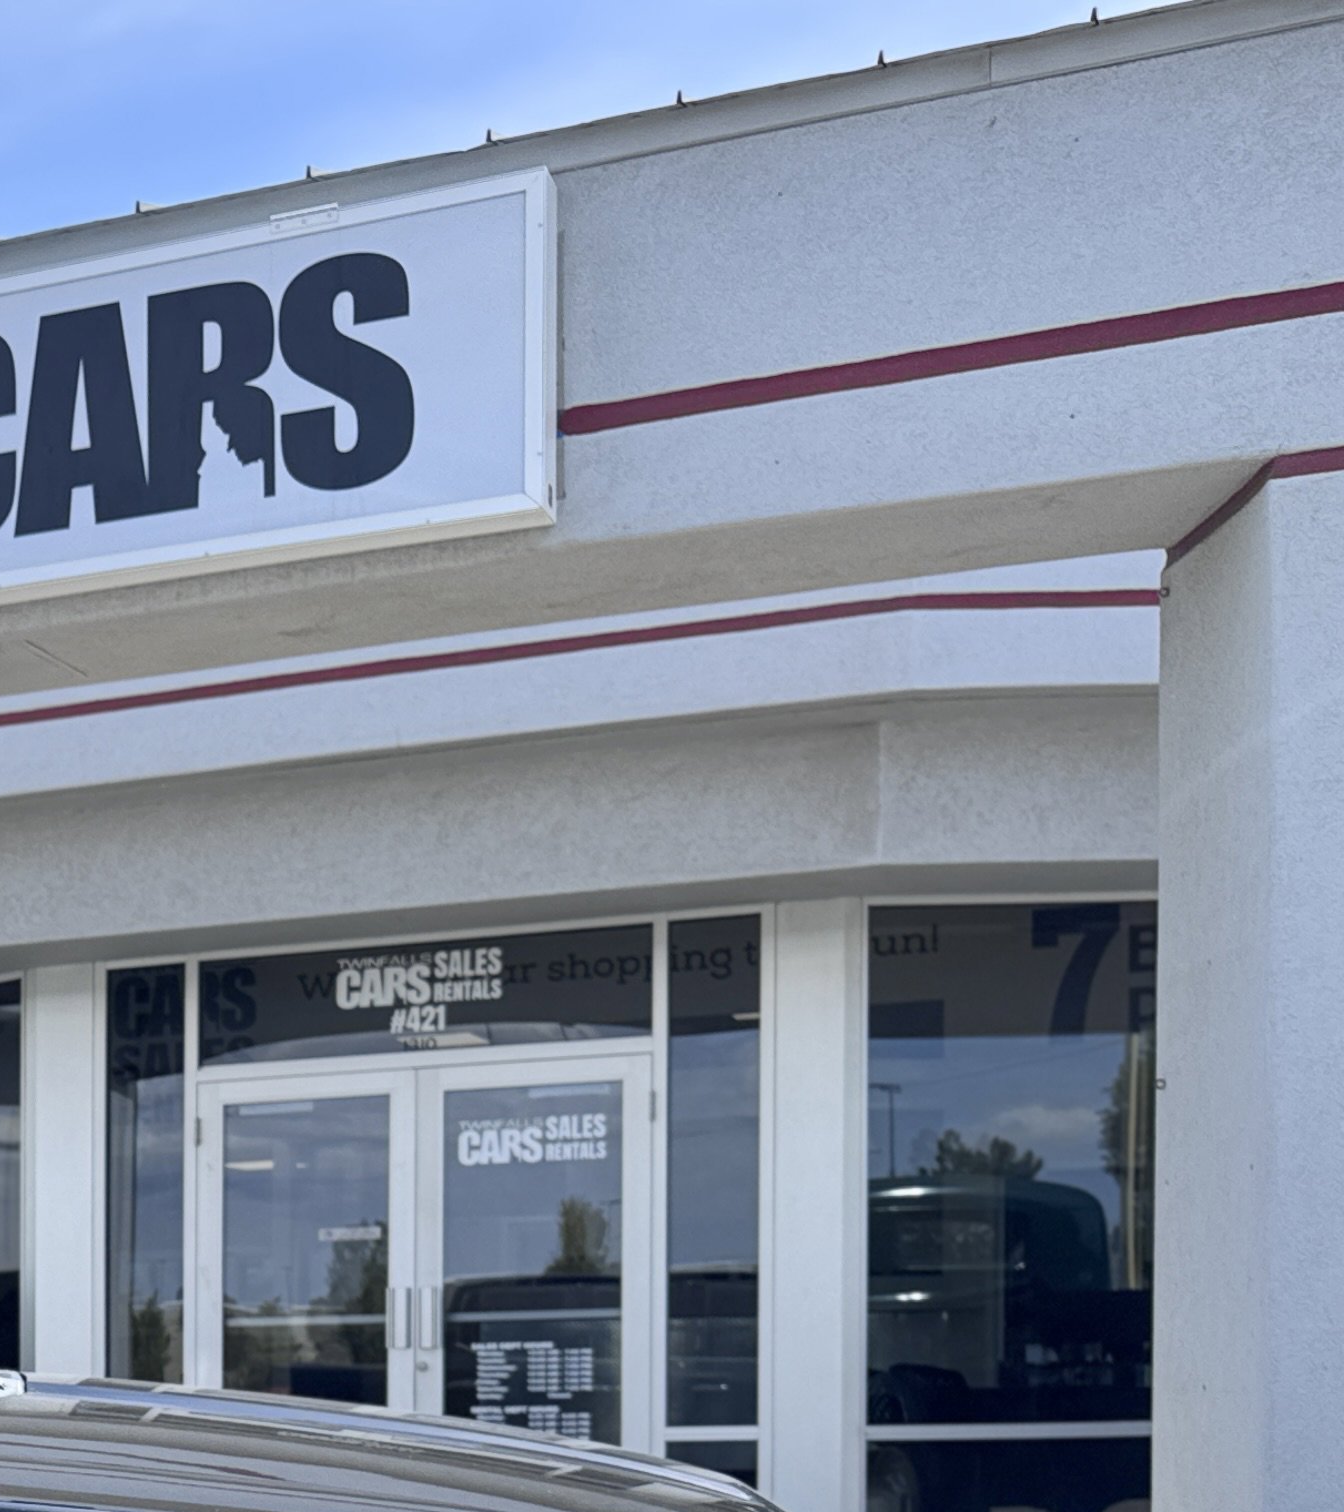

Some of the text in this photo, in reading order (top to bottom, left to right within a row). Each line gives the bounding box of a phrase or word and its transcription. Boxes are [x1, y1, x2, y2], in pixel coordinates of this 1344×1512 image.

[433, 948, 503, 979] SALES
[335, 963, 432, 1010] CARS
[433, 977, 503, 1003] RENTALS
[390, 1005, 446, 1034] #421
[545, 1113, 607, 1140] SALES
[457, 1125, 543, 1166] CARS
[545, 1140, 608, 1162] RENTALS
